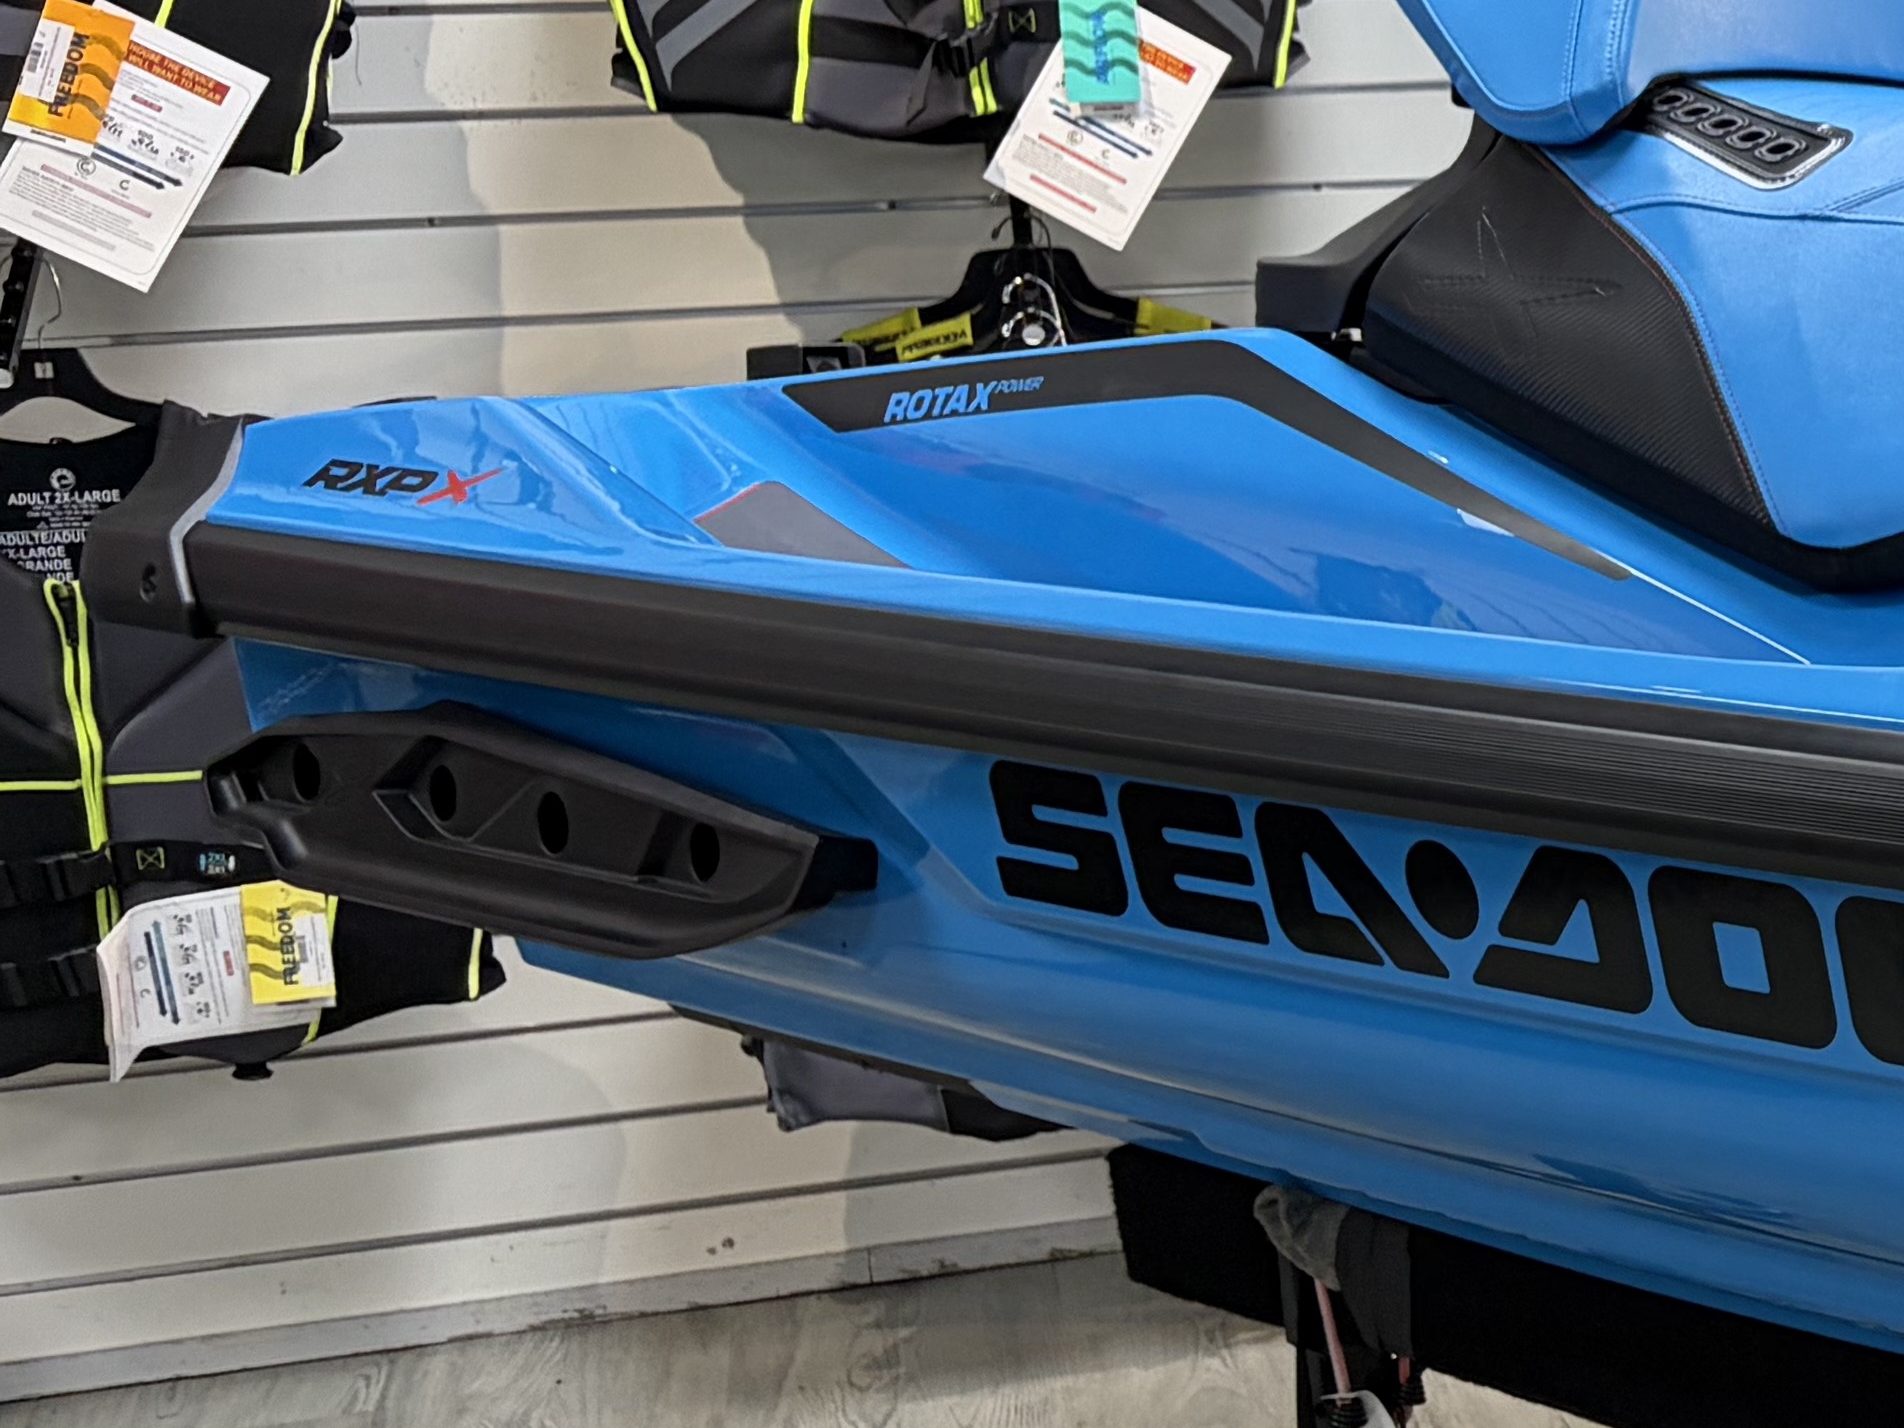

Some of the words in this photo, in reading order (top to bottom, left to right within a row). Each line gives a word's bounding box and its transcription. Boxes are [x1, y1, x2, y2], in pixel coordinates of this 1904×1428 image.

[47, 31, 91, 119] FREEDOM
[884, 380, 998, 424] ROTAX
[7, 491, 51, 506] ADULT
[54, 489, 121, 504] 2X-LARGE
[302, 458, 439, 497] RXP
[276, 907, 299, 986] FREEDOM
